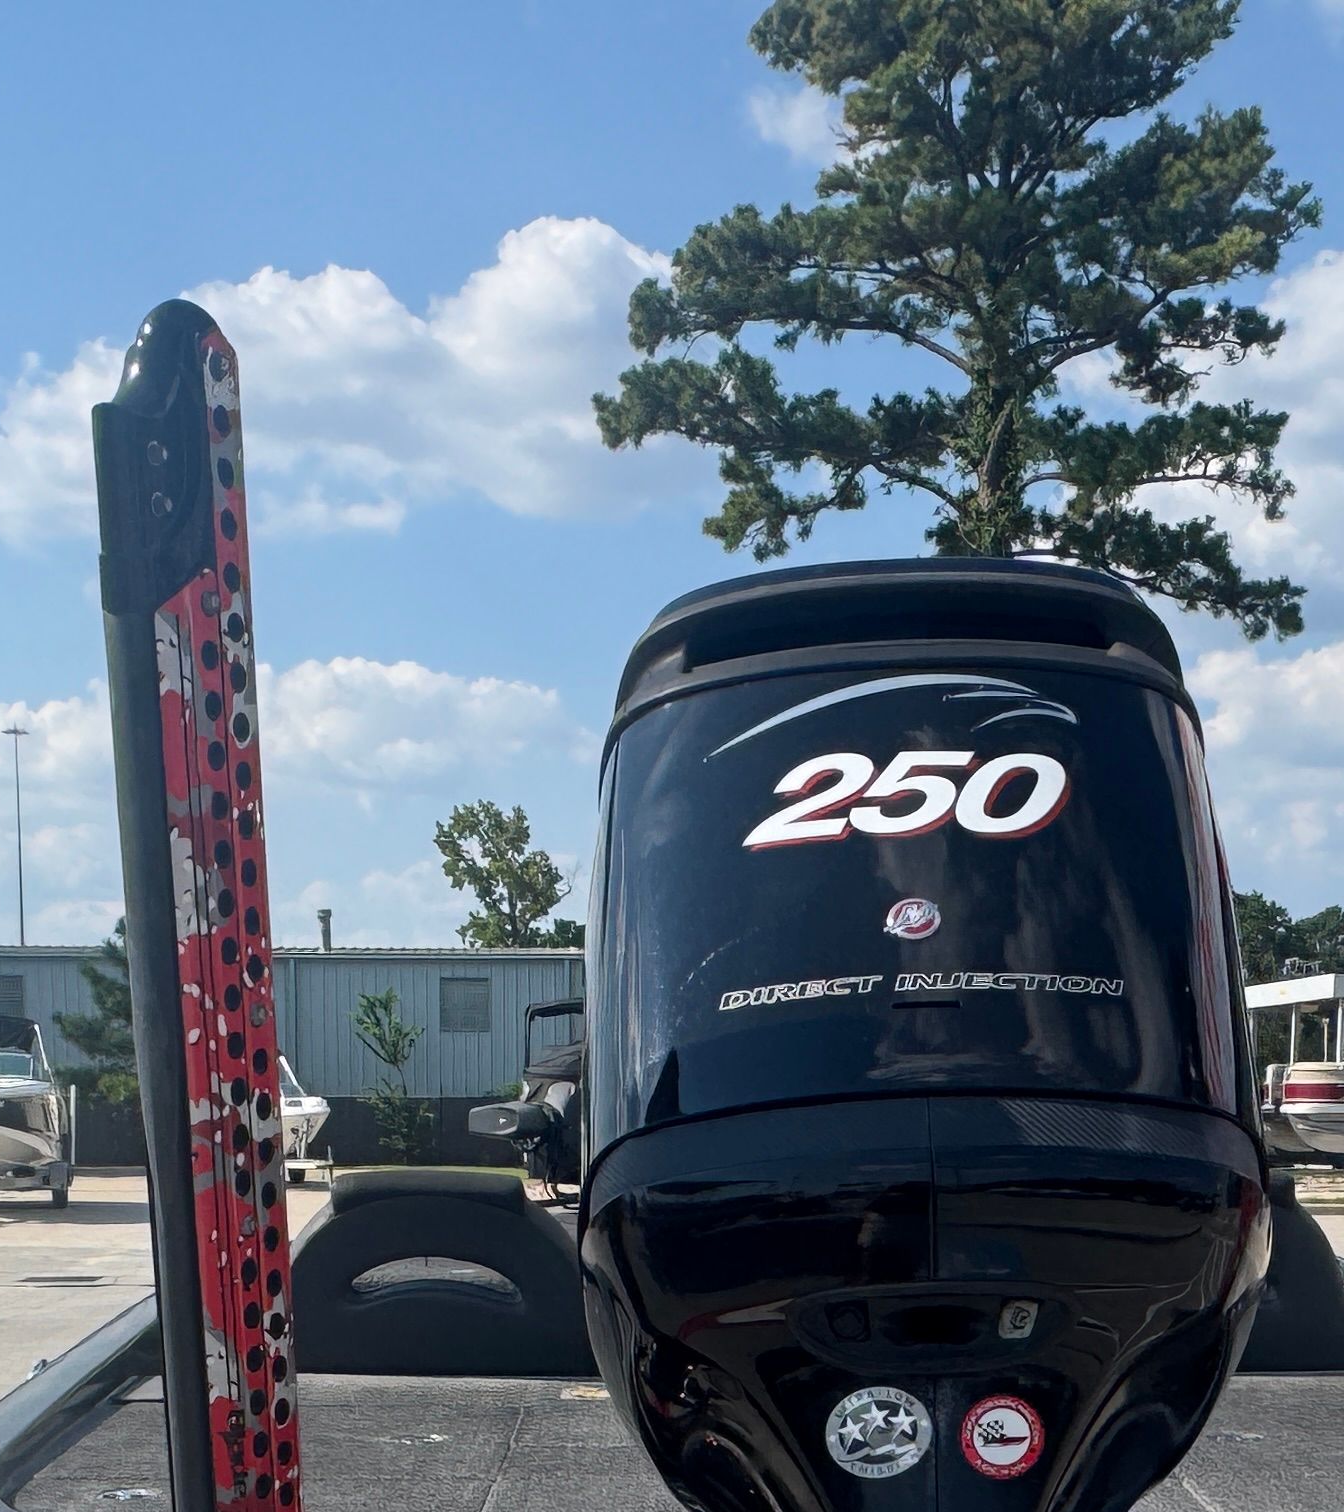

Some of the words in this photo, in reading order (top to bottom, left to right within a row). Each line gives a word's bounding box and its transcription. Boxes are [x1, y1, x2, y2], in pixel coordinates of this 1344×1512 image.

[742, 750, 1072, 851] 250
[718, 975, 883, 1011] DIRECT
[894, 972, 1124, 995] INJECTION
